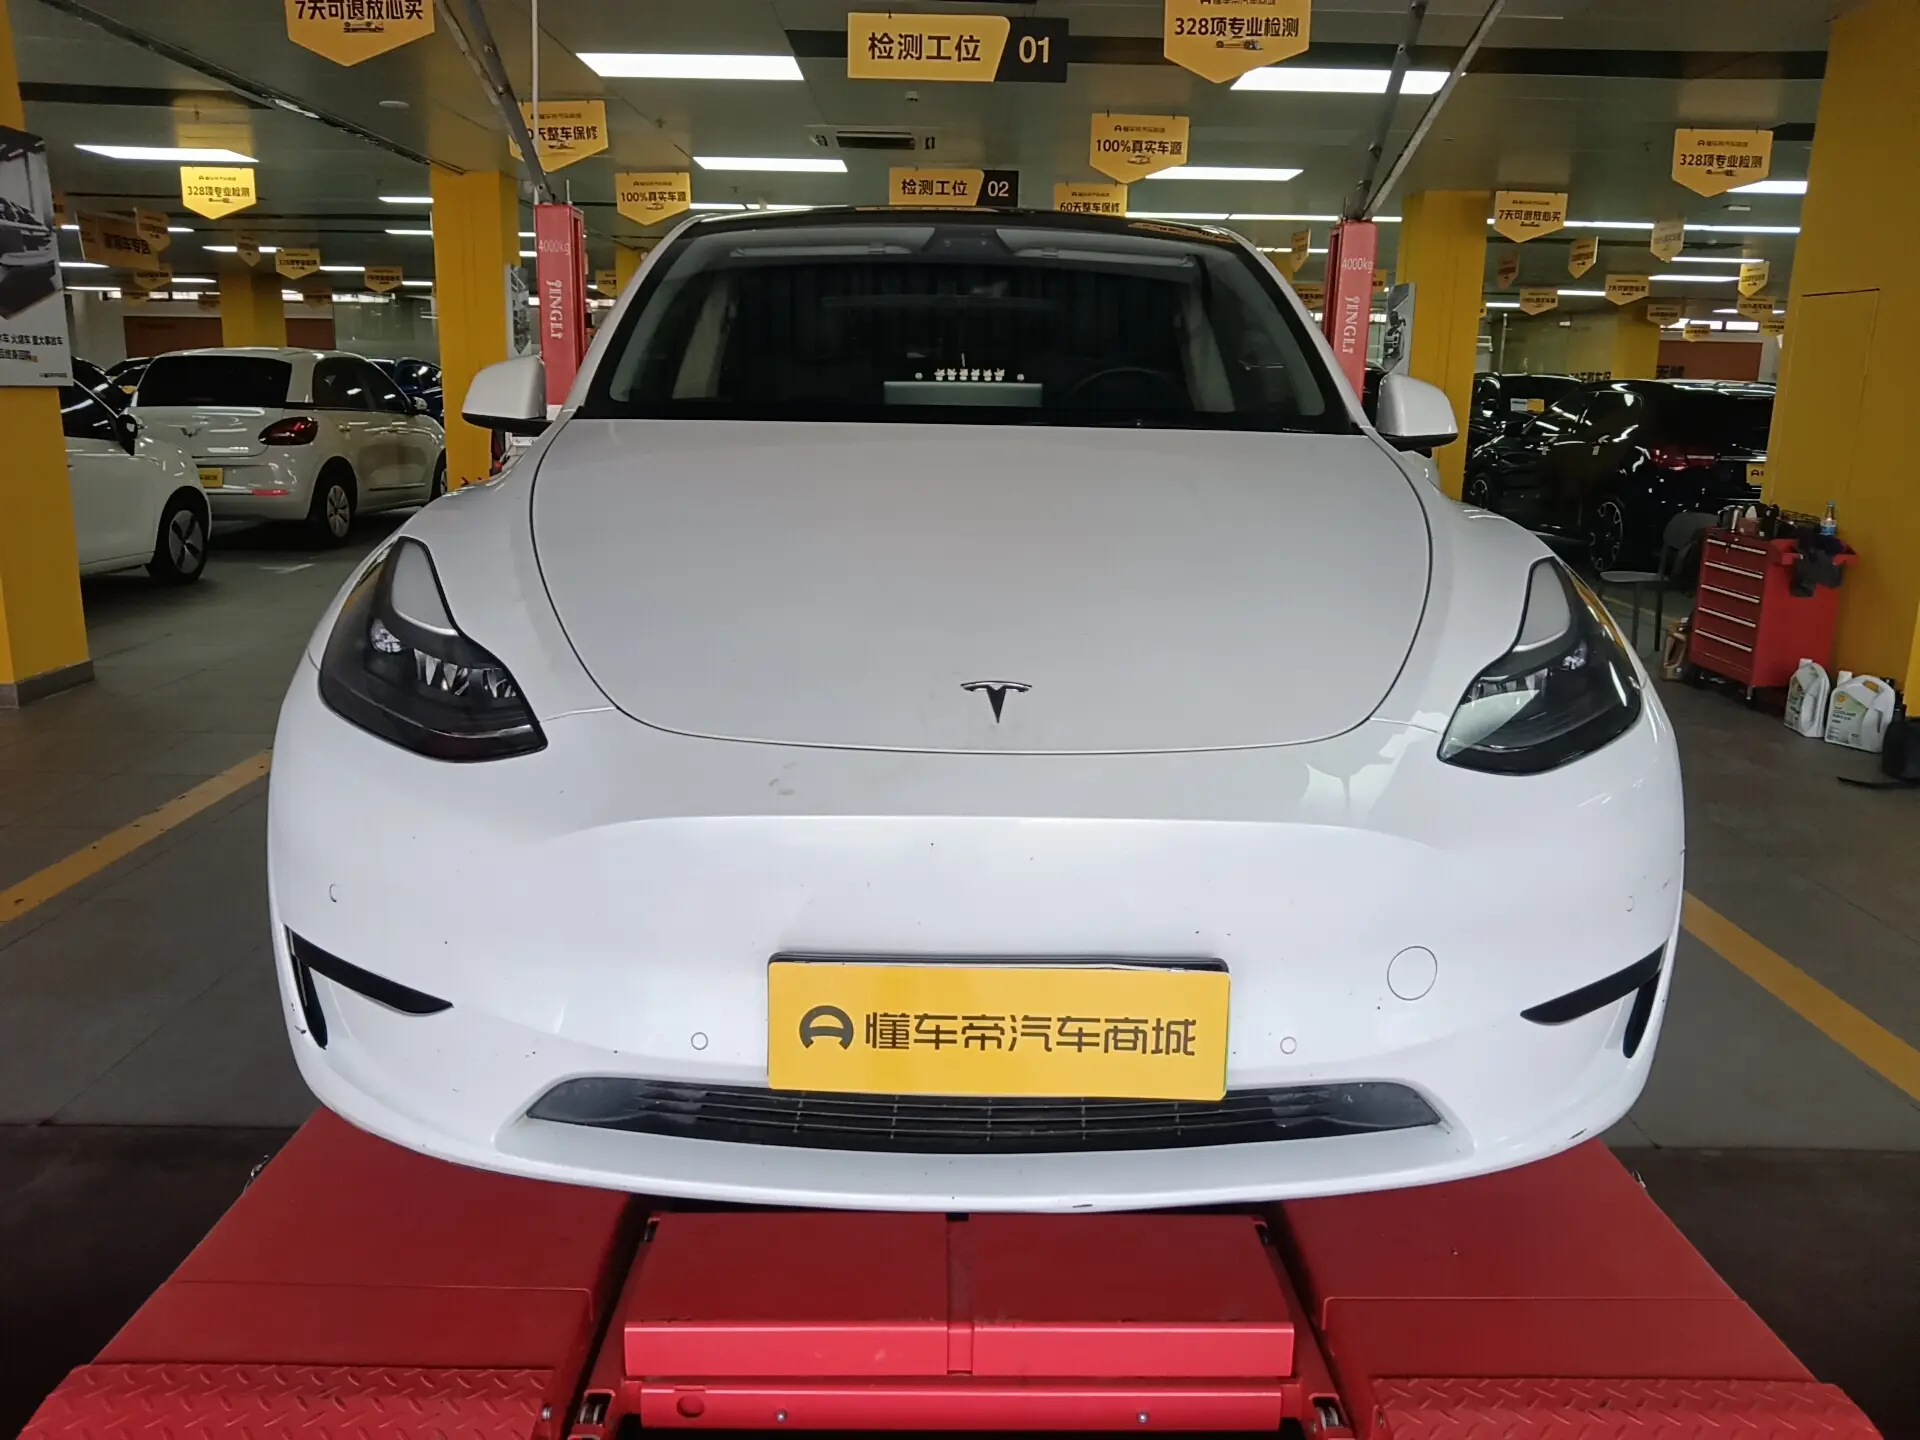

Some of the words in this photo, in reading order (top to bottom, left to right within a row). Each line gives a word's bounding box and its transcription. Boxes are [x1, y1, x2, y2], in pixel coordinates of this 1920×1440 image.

[295, 0, 423, 20] 7天可退放心买
[1174, 16, 1300, 38] 328项专业检测
[868, 32, 981, 62] 检测工位
[1018, 36, 1050, 63] 01
[1096, 139, 1183, 155] 100%真实车源
[1680, 153, 1763, 169] 328项专业检测
[187, 185, 250, 197] 328项专业检测
[620, 190, 687, 202] 100%真实车源
[901, 179, 968, 197] 检测工位
[987, 180, 1009, 197] 02
[1060, 201, 1121, 213] 60天整车保修
[1341, 257, 1374, 273] 4000kg
[865, 1010, 1197, 1056] 懂车帝汽车商城
